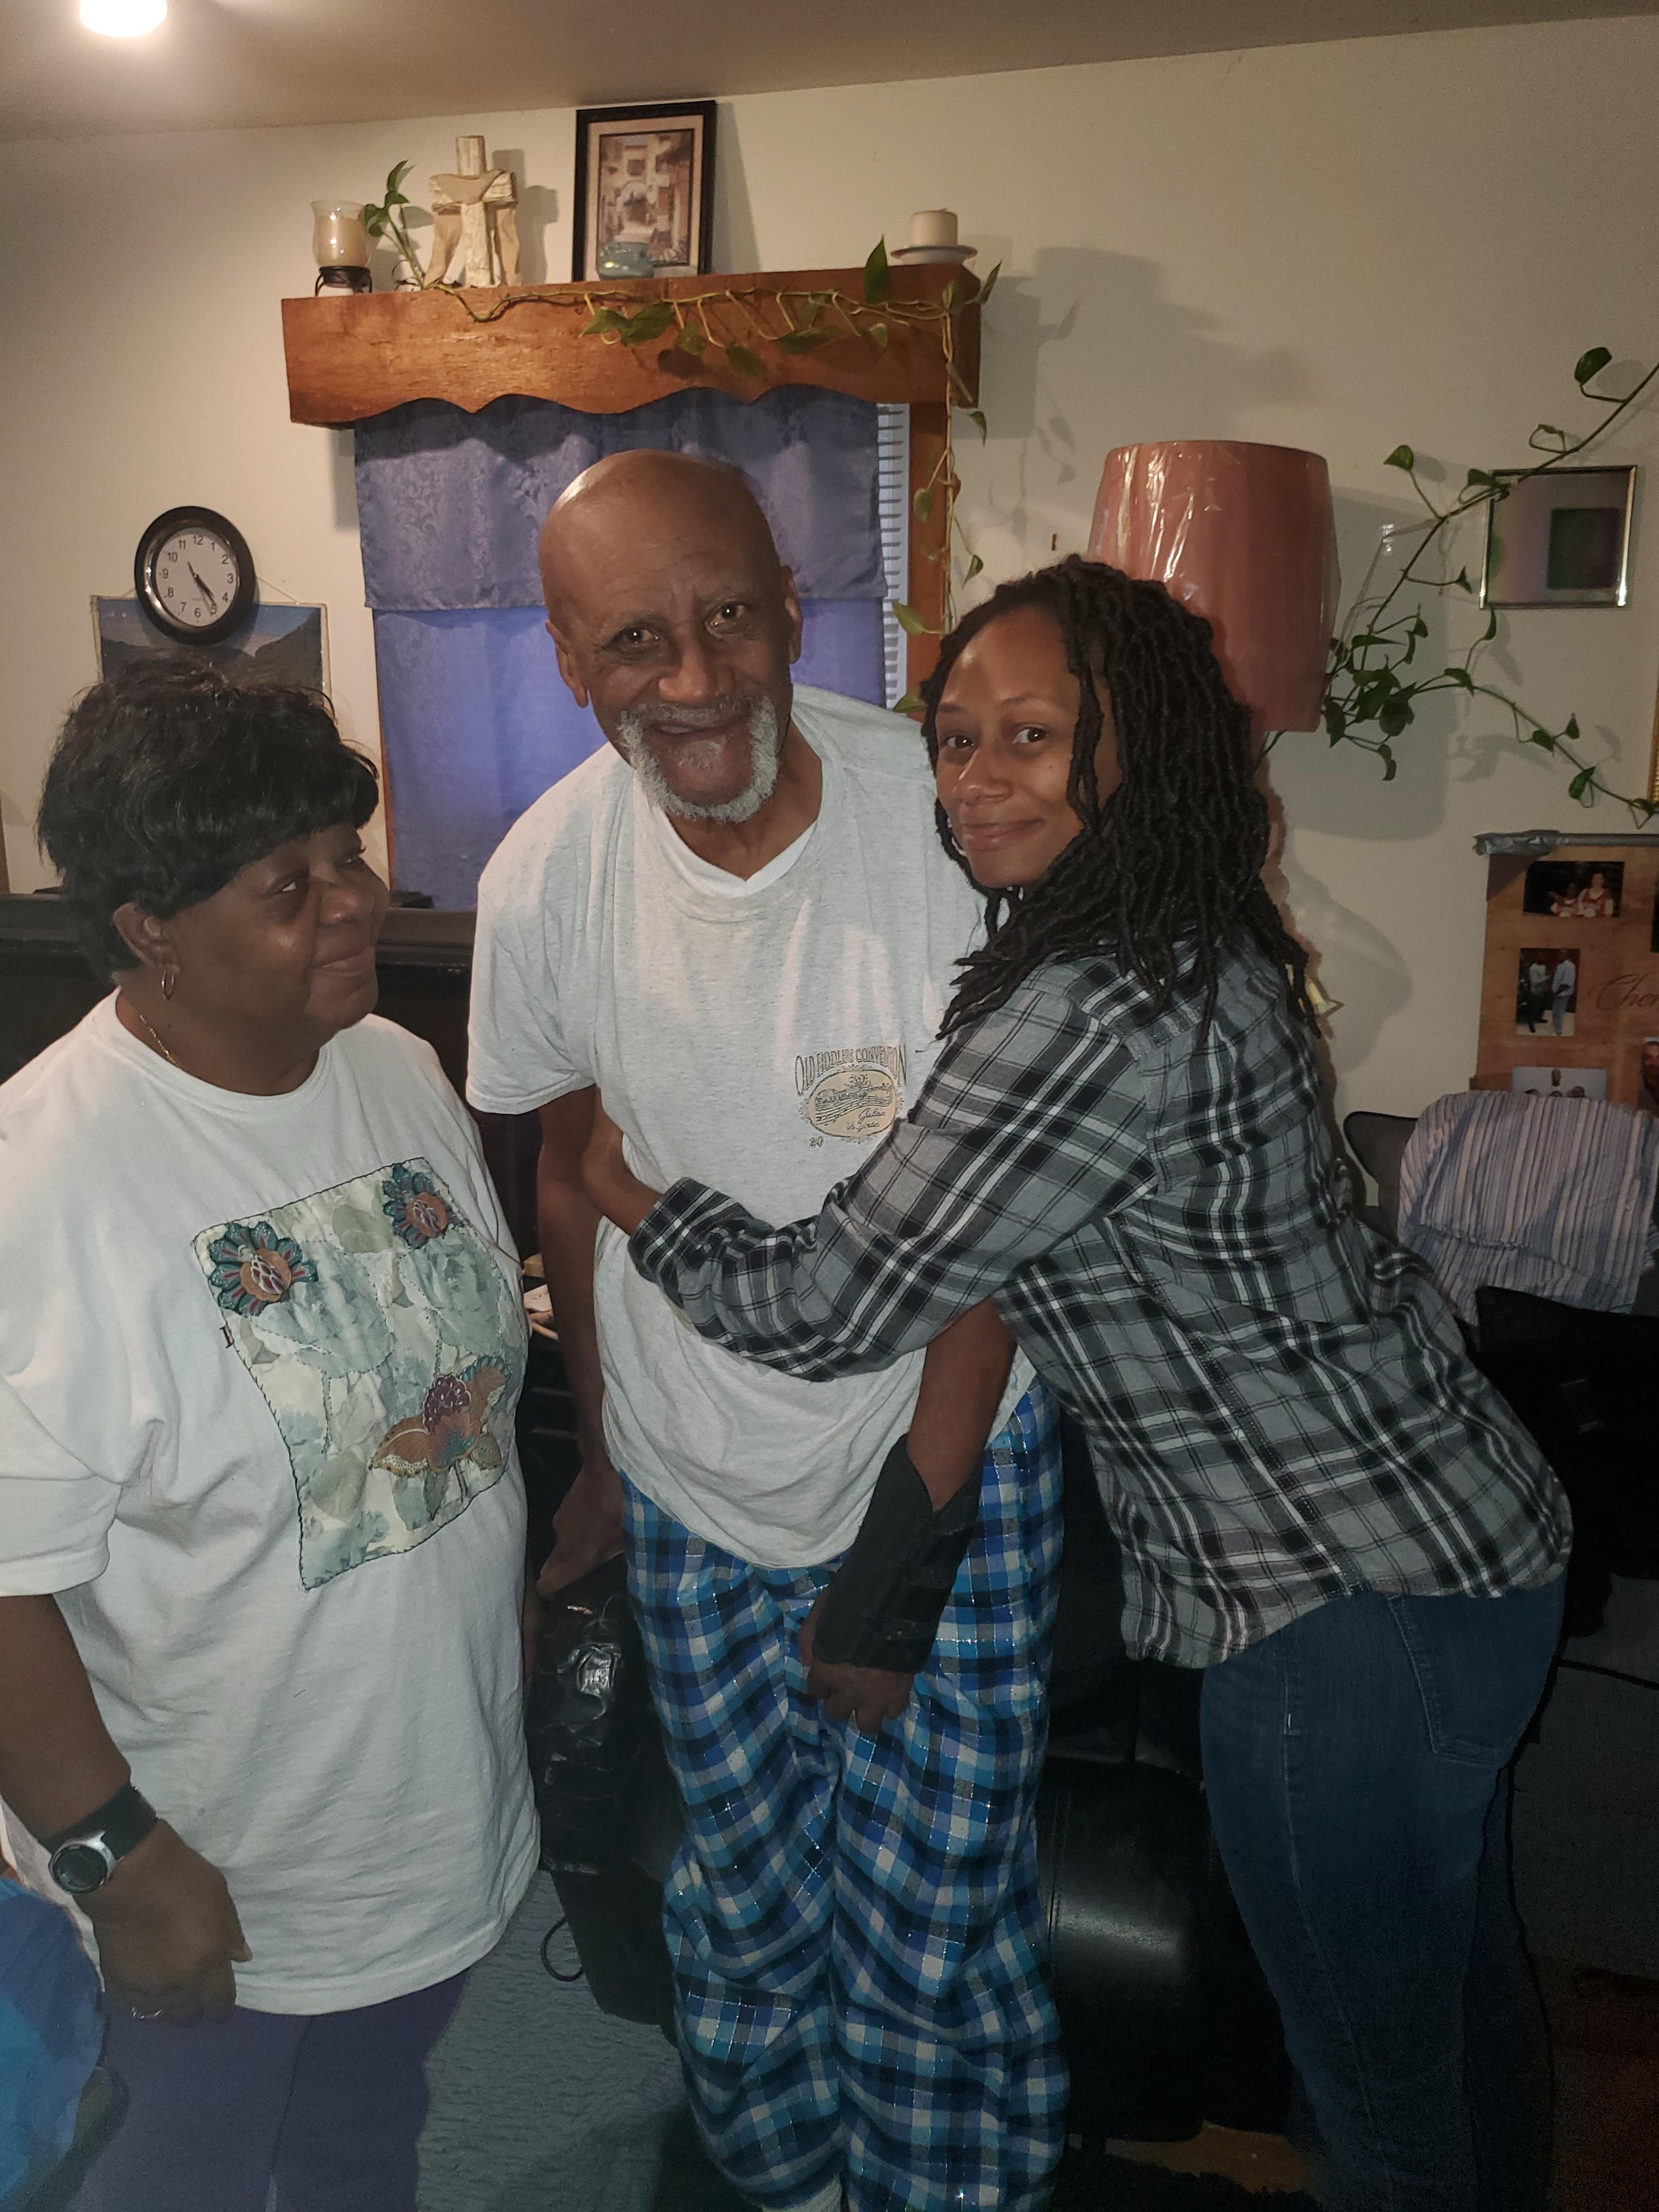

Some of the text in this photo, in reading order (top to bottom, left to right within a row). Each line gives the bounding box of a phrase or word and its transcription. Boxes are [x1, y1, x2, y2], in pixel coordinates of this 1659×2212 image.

[179, 540, 186, 549] 11
[193, 535, 204, 545] 12
[211, 542, 216, 551] 1
[168, 552, 178, 562] 10
[222, 554, 229, 564] 2
[162, 568, 168, 579] 9
[227, 574, 234, 584] 3
[168, 588, 174, 597] 8
[222, 592, 228, 603] 4
[180, 602, 187, 612] 7
[210, 603, 217, 615] 5
[195, 608, 201, 618] 6
[795, 1054, 815, 1097] OLD
